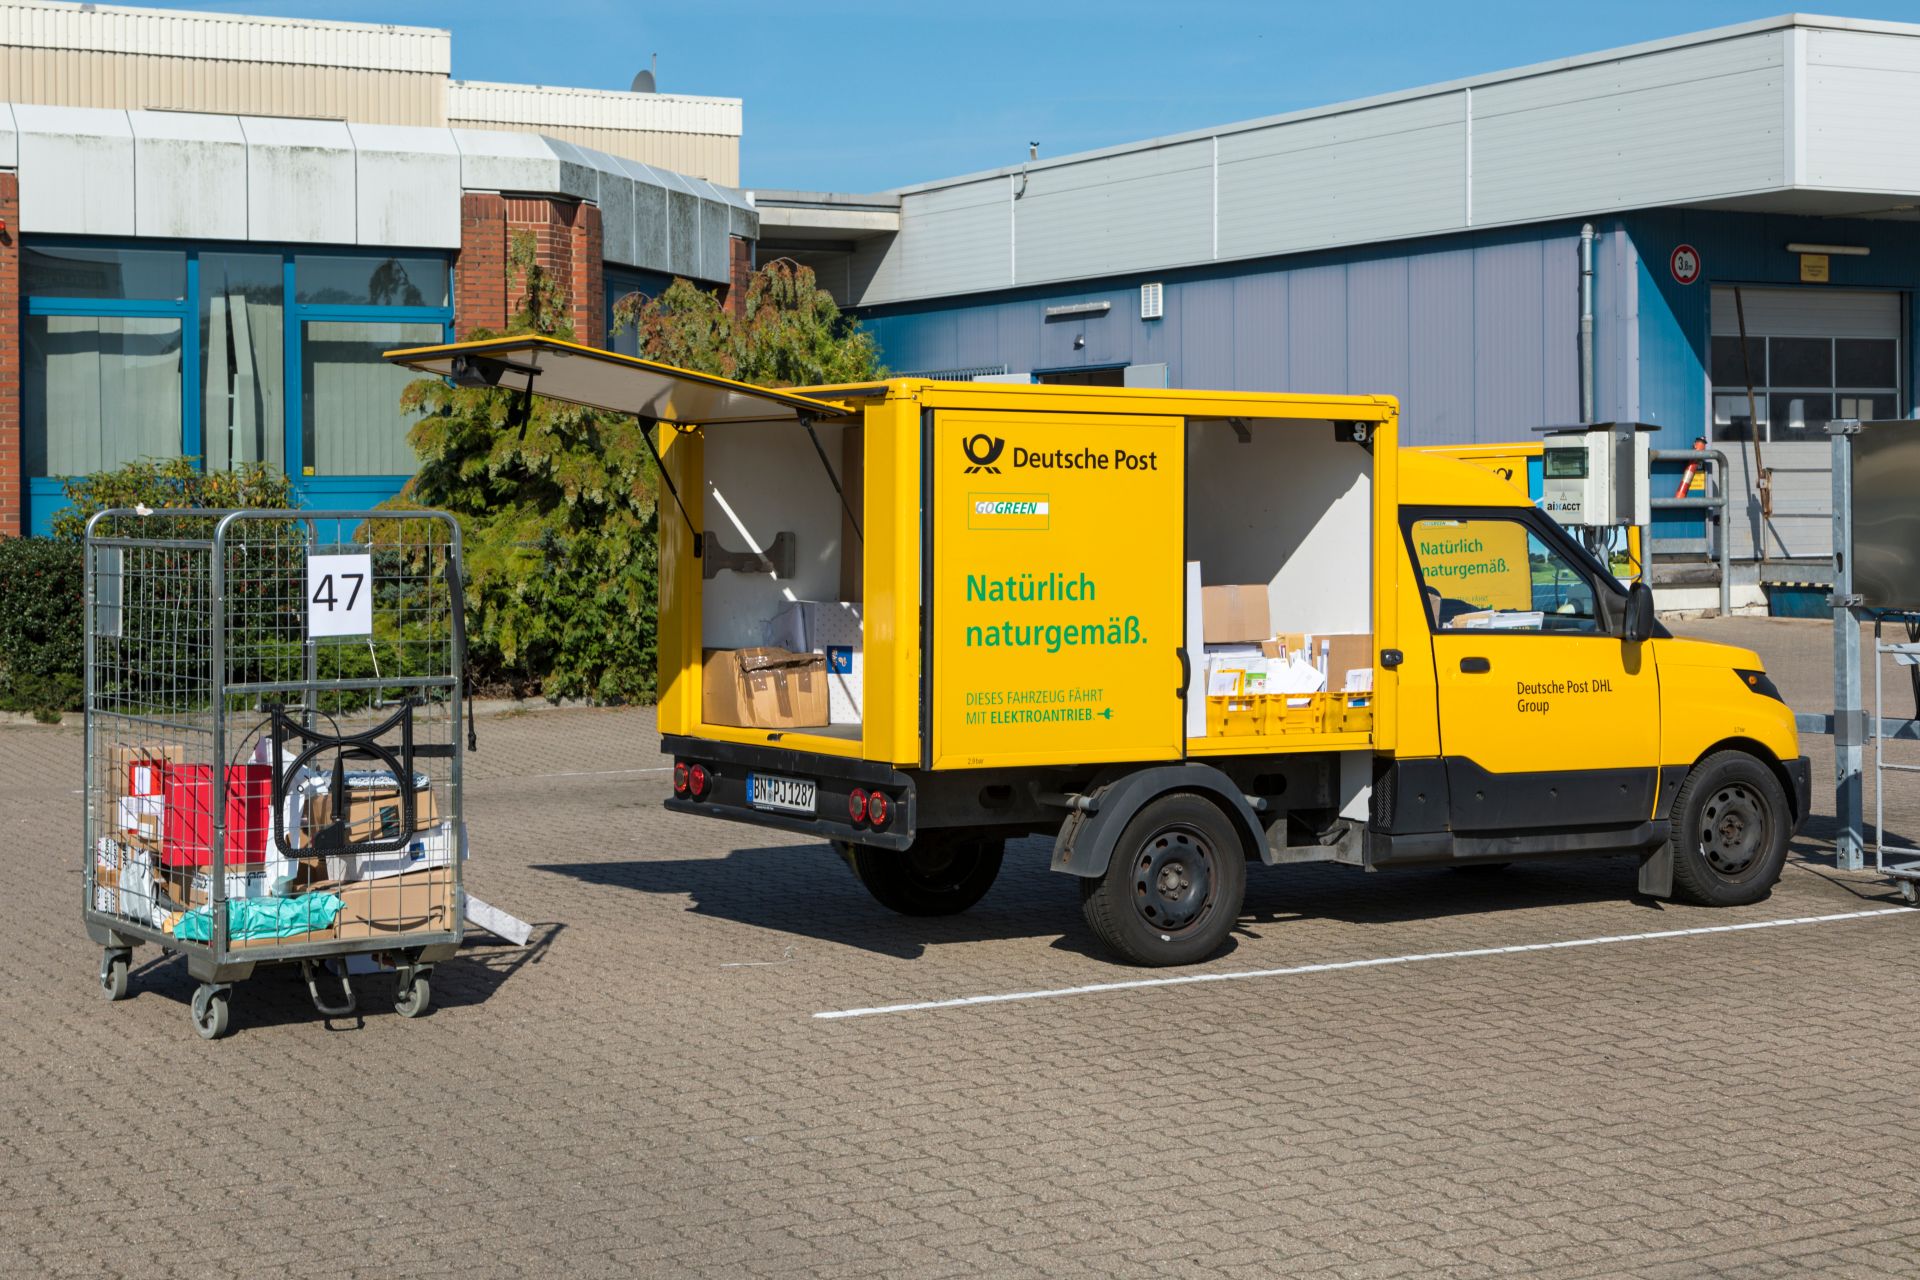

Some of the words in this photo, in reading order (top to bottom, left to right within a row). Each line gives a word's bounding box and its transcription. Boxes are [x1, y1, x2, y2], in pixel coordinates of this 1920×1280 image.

[1013, 447, 1109, 470] Deutsche
[1114, 449, 1158, 471] Post
[975, 502, 1038, 515] GOGREEN
[1420, 539, 1484, 556] Natürlich
[1421, 558, 1511, 580] naturgemäß.
[312, 573, 364, 612] 47
[966, 572, 1096, 602] Natürlich
[966, 615, 1148, 654] naturgemäß.
[966, 692, 1004, 706] DIESES
[1007, 690, 1065, 704] FAHRZEUG
[1068, 687, 1104, 702] FÄHRT
[1517, 680, 1565, 695] Deutsche
[1567, 680, 1589, 694] Post
[1592, 679, 1613, 693] DHL
[966, 711, 987, 725] MIT
[991, 708, 1095, 724] ELEKTROANTRIEB.
[1517, 699, 1550, 715] Group
[754, 777, 767, 801] BN
